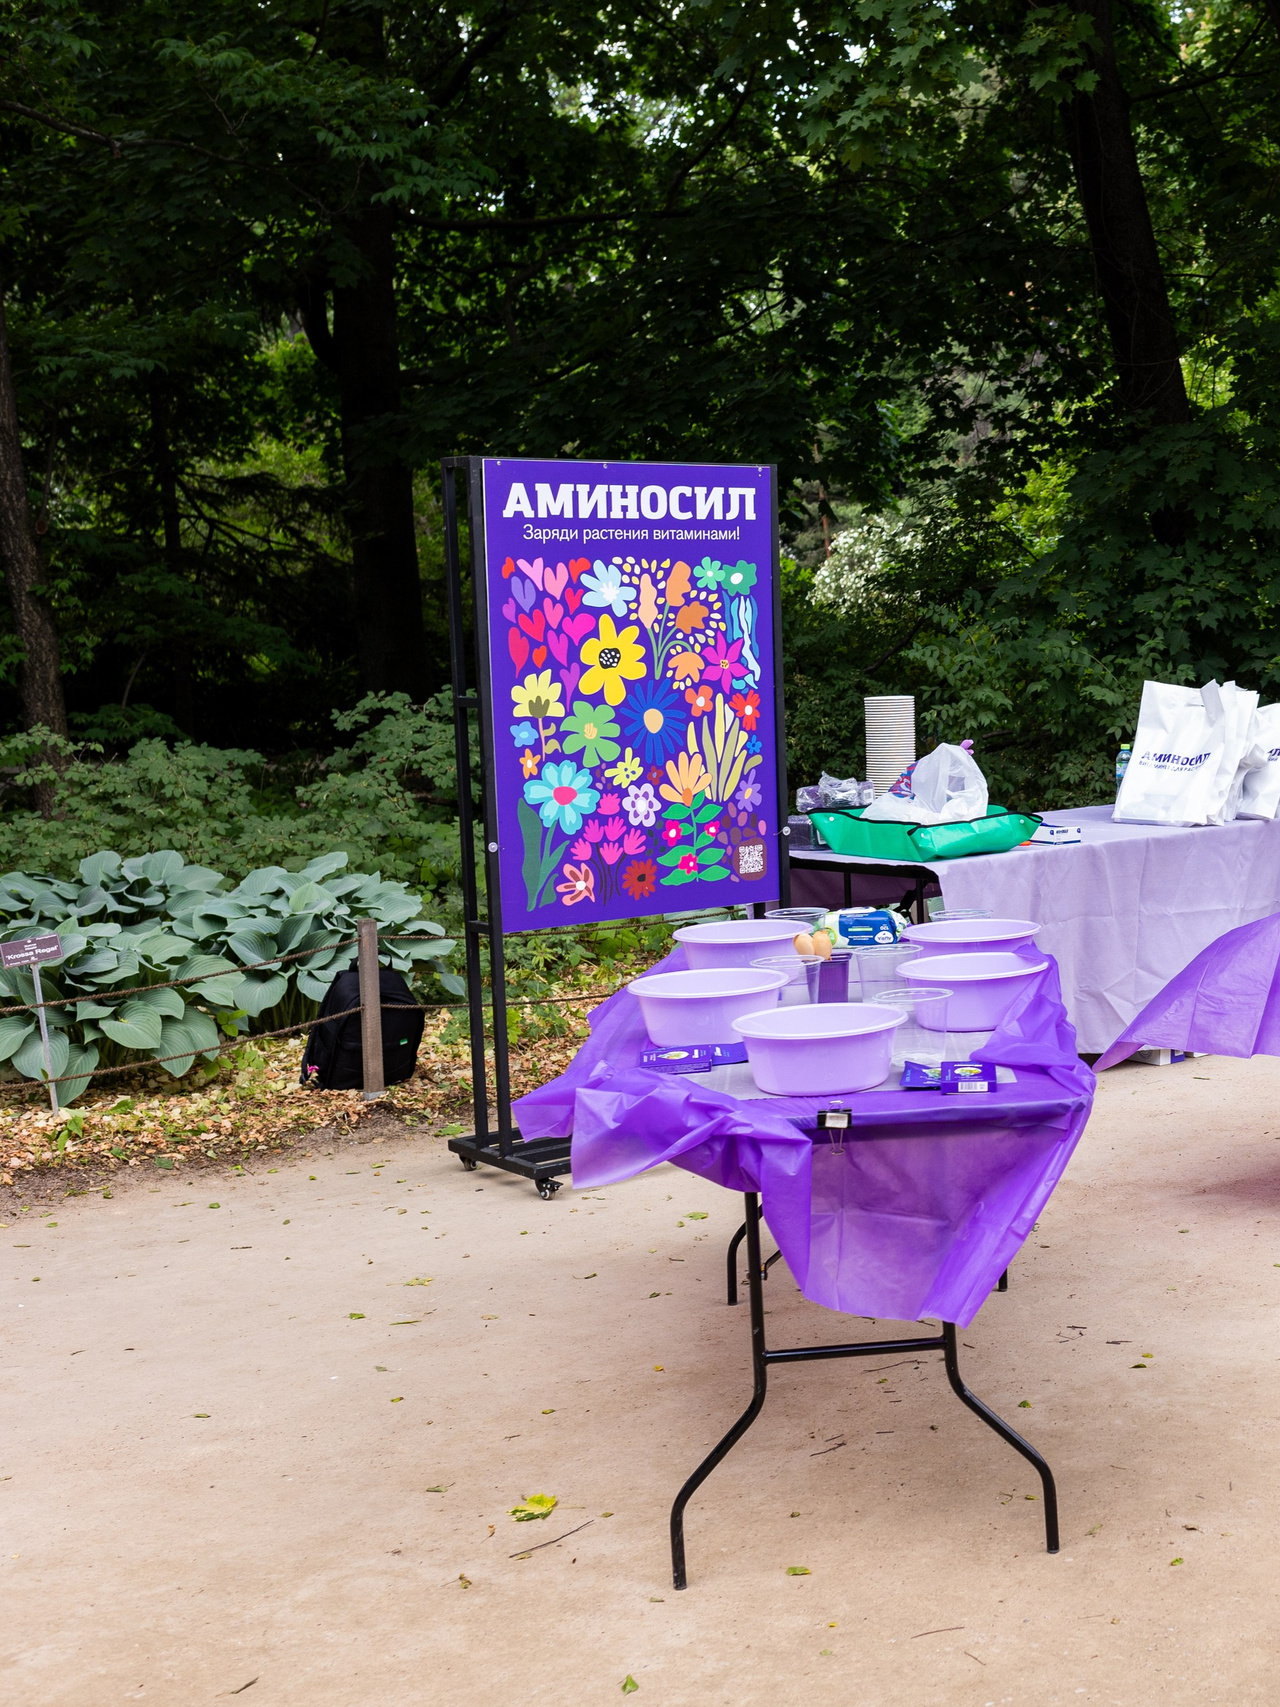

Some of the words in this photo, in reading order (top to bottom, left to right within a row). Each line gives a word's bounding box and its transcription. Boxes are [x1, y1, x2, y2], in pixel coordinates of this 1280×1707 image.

[502, 482, 757, 521] АМИНОСИЛ
[523, 524, 579, 544] Заряди
[583, 527, 649, 544] растения
[653, 526, 740, 541] витаминами!
[1141, 751, 1211, 766] АМИНОСИЛ
